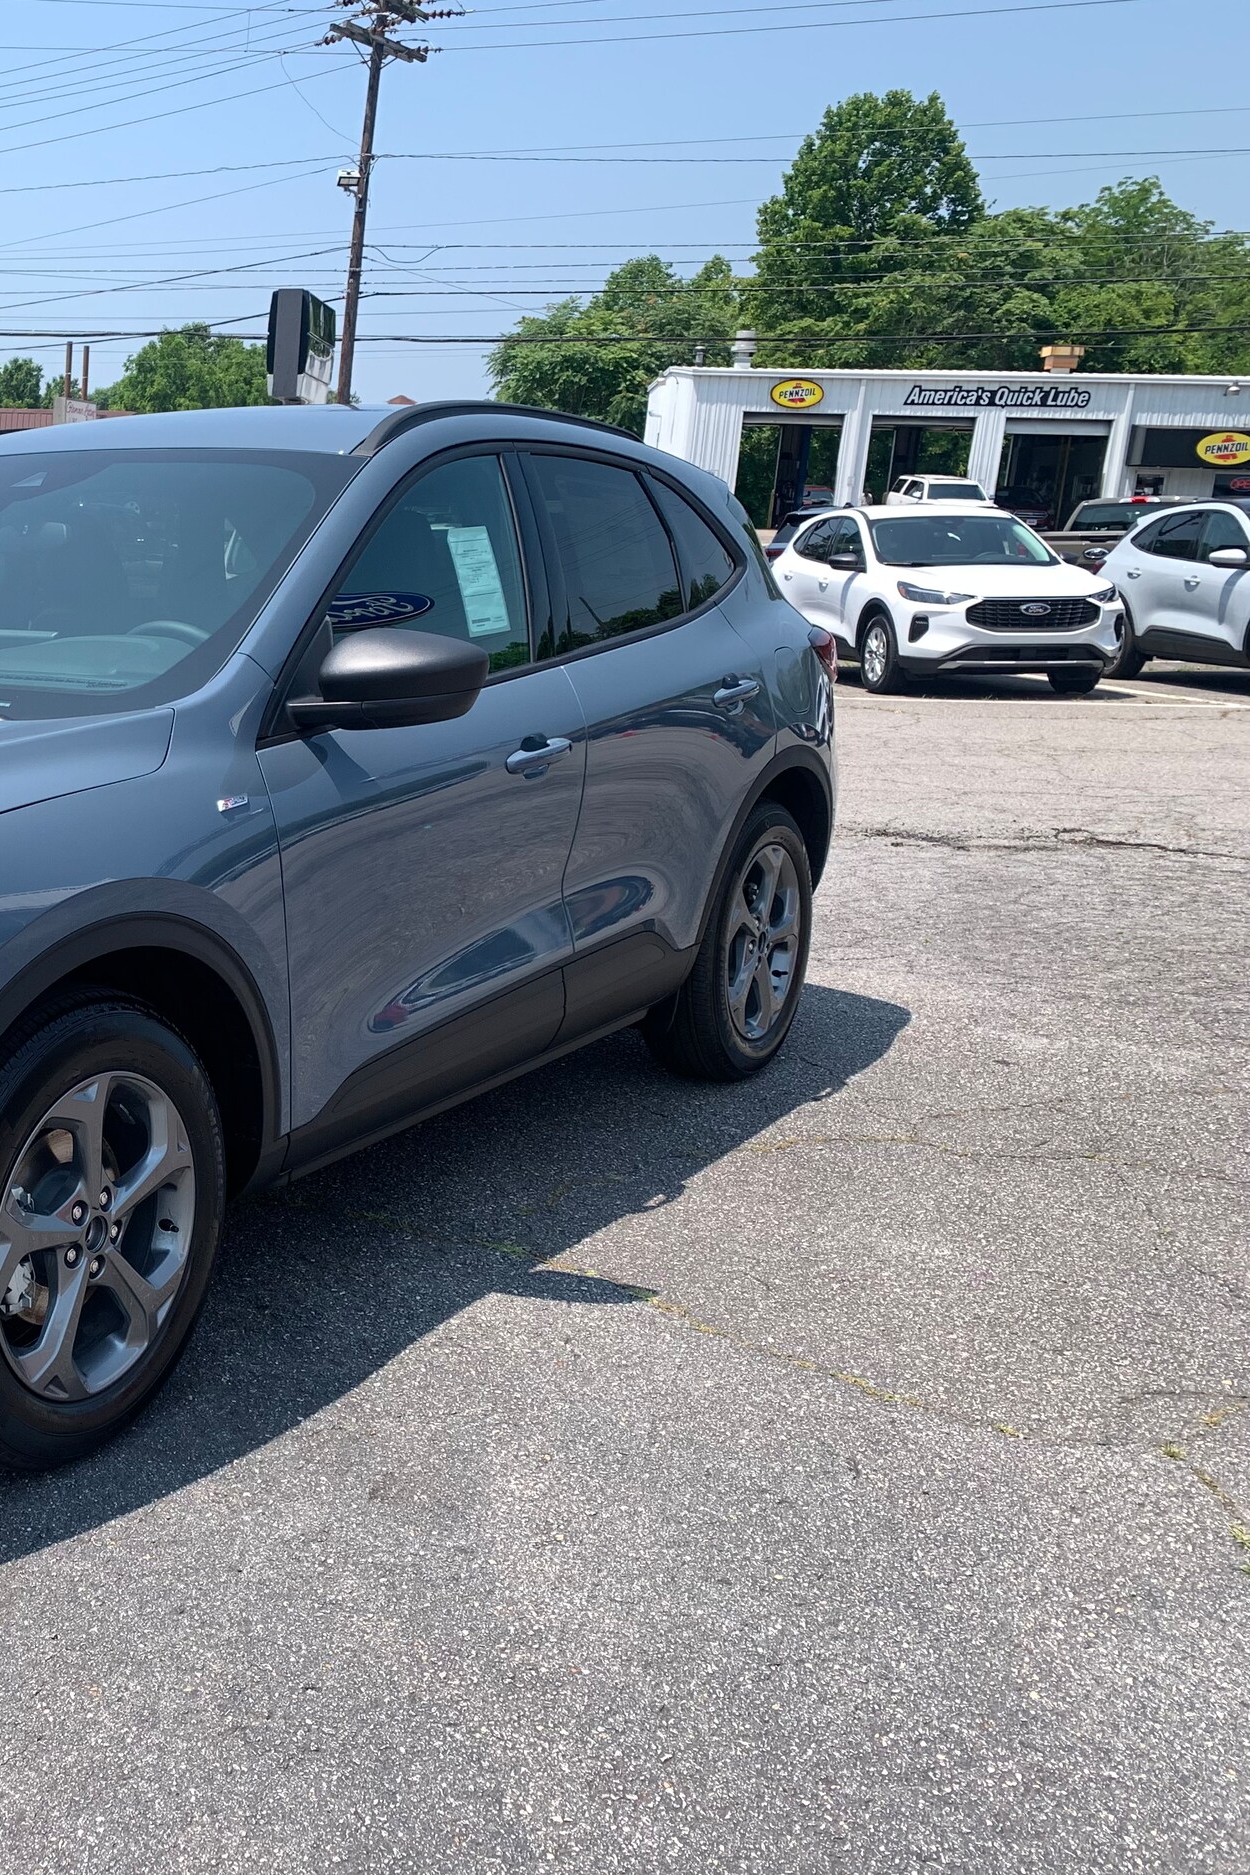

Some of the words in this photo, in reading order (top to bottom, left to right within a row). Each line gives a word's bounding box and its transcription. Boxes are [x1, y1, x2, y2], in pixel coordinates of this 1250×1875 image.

[778, 388, 817, 399] PENNZOIL
[906, 387, 991, 405] America's
[995, 387, 1045, 408] Quick
[1046, 388, 1091, 407] Lube
[1204, 442, 1249, 455] PENNZOIL
[1231, 479, 1250, 489] OPE
